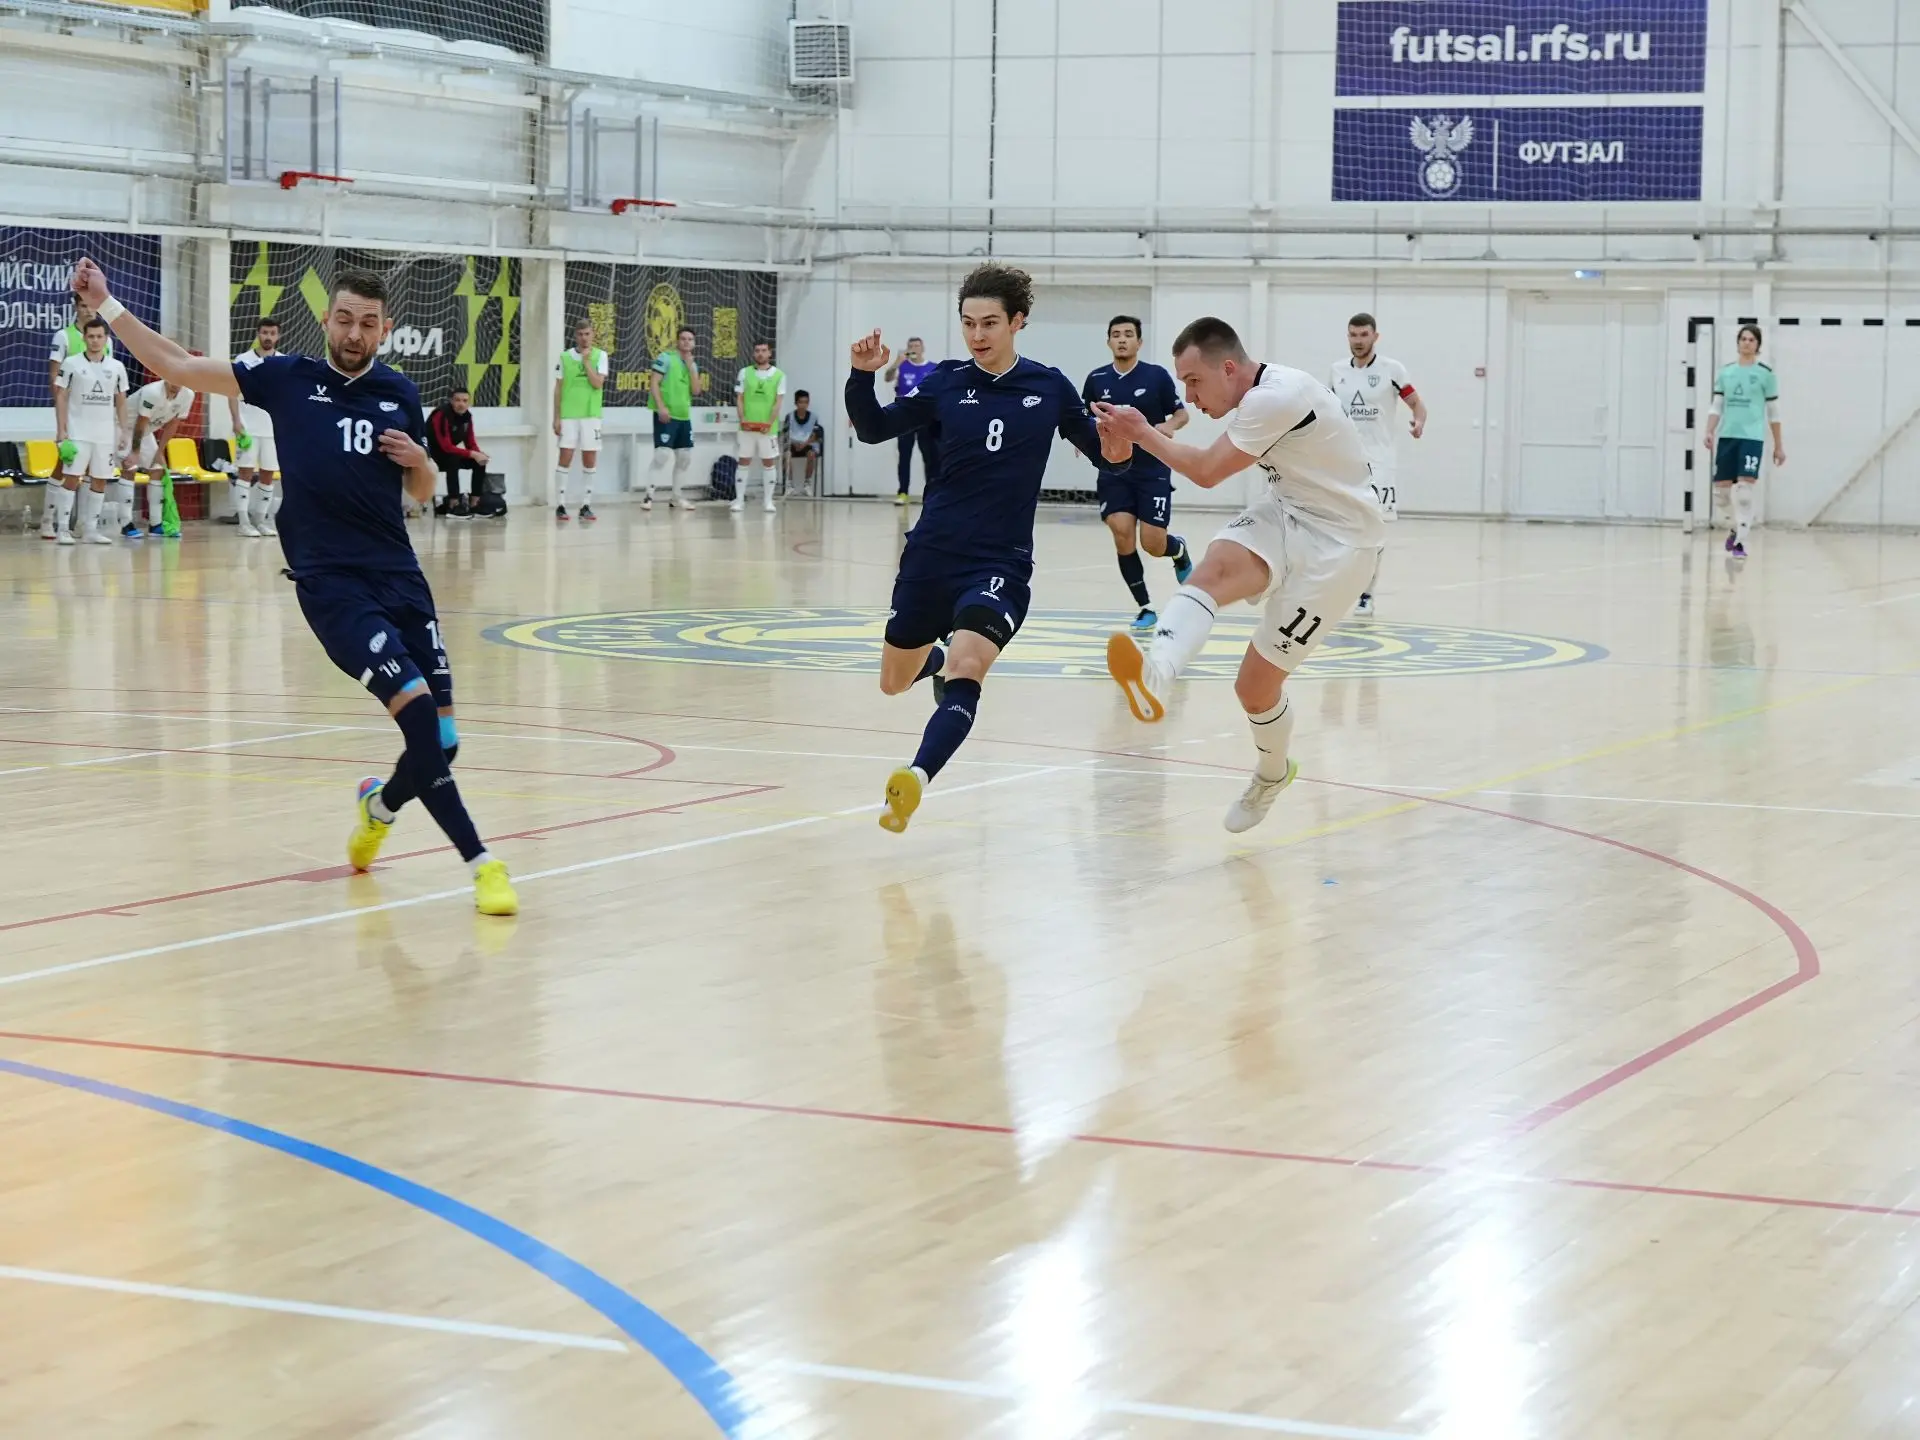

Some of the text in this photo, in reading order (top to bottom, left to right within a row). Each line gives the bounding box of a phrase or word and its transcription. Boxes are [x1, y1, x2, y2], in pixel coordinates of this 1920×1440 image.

[1389, 24, 1650, 63] futsal.rfs.ru
[1518, 140, 1624, 164] ФУТЗАЛ
[336, 417, 374, 455] 18
[985, 418, 1005, 452] 8
[1744, 454, 1759, 470] 12
[1153, 497, 1167, 511] 77
[1278, 606, 1322, 645] 11
